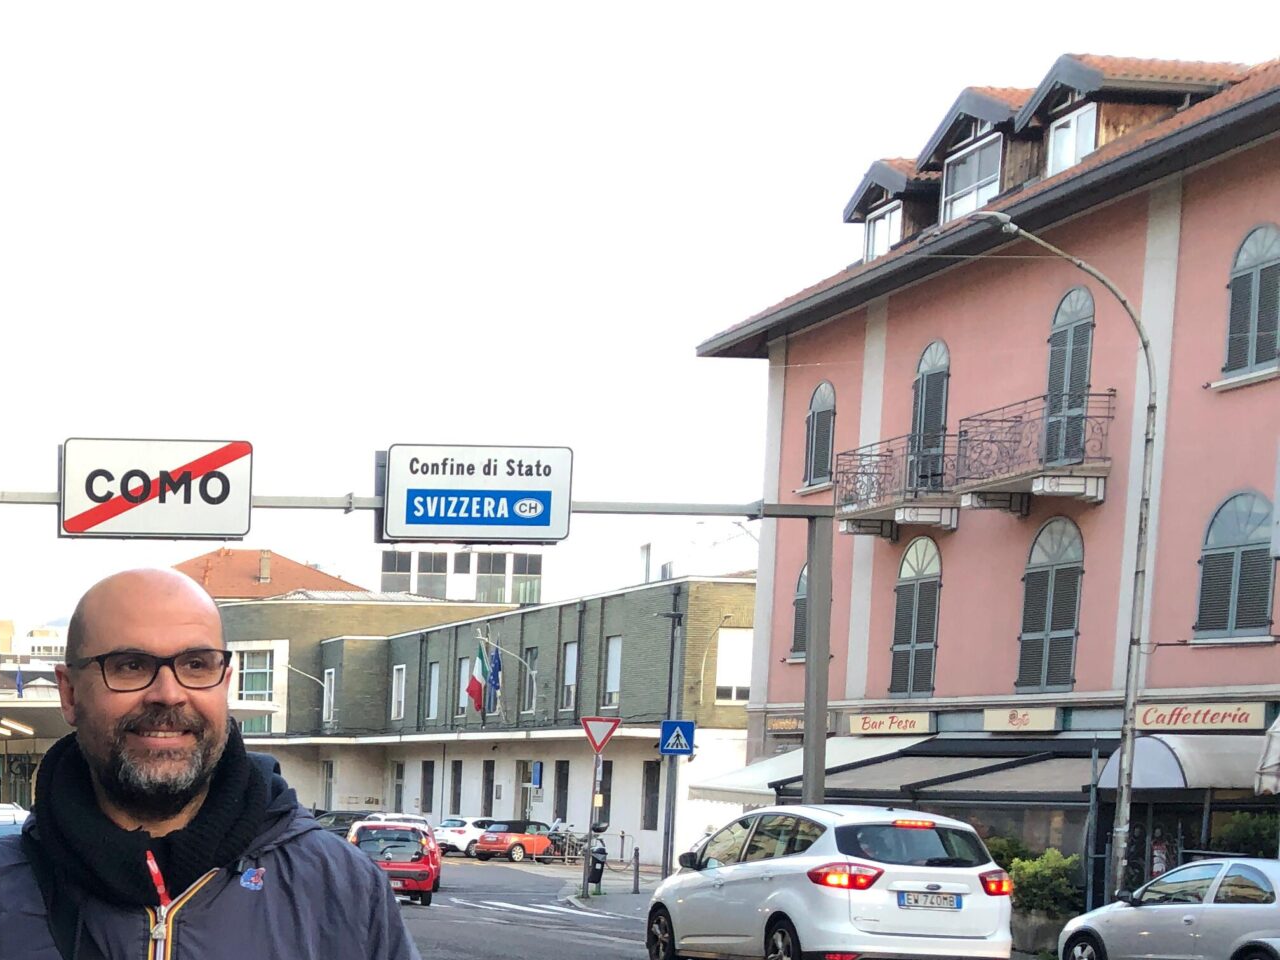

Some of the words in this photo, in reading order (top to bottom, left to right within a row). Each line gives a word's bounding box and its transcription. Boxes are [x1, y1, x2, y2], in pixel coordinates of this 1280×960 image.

[409, 457, 475, 476] Confine
[483, 458, 497, 476] di
[506, 459, 552, 477] Stato
[85, 468, 231, 505] COMO
[413, 496, 509, 518] SVIZZERA
[518, 502, 538, 514] CH
[861, 716, 885, 731] Bar
[888, 715, 918, 731] Pesa
[1142, 704, 1251, 726] Caffetteria
[906, 892, 920, 905] EW
